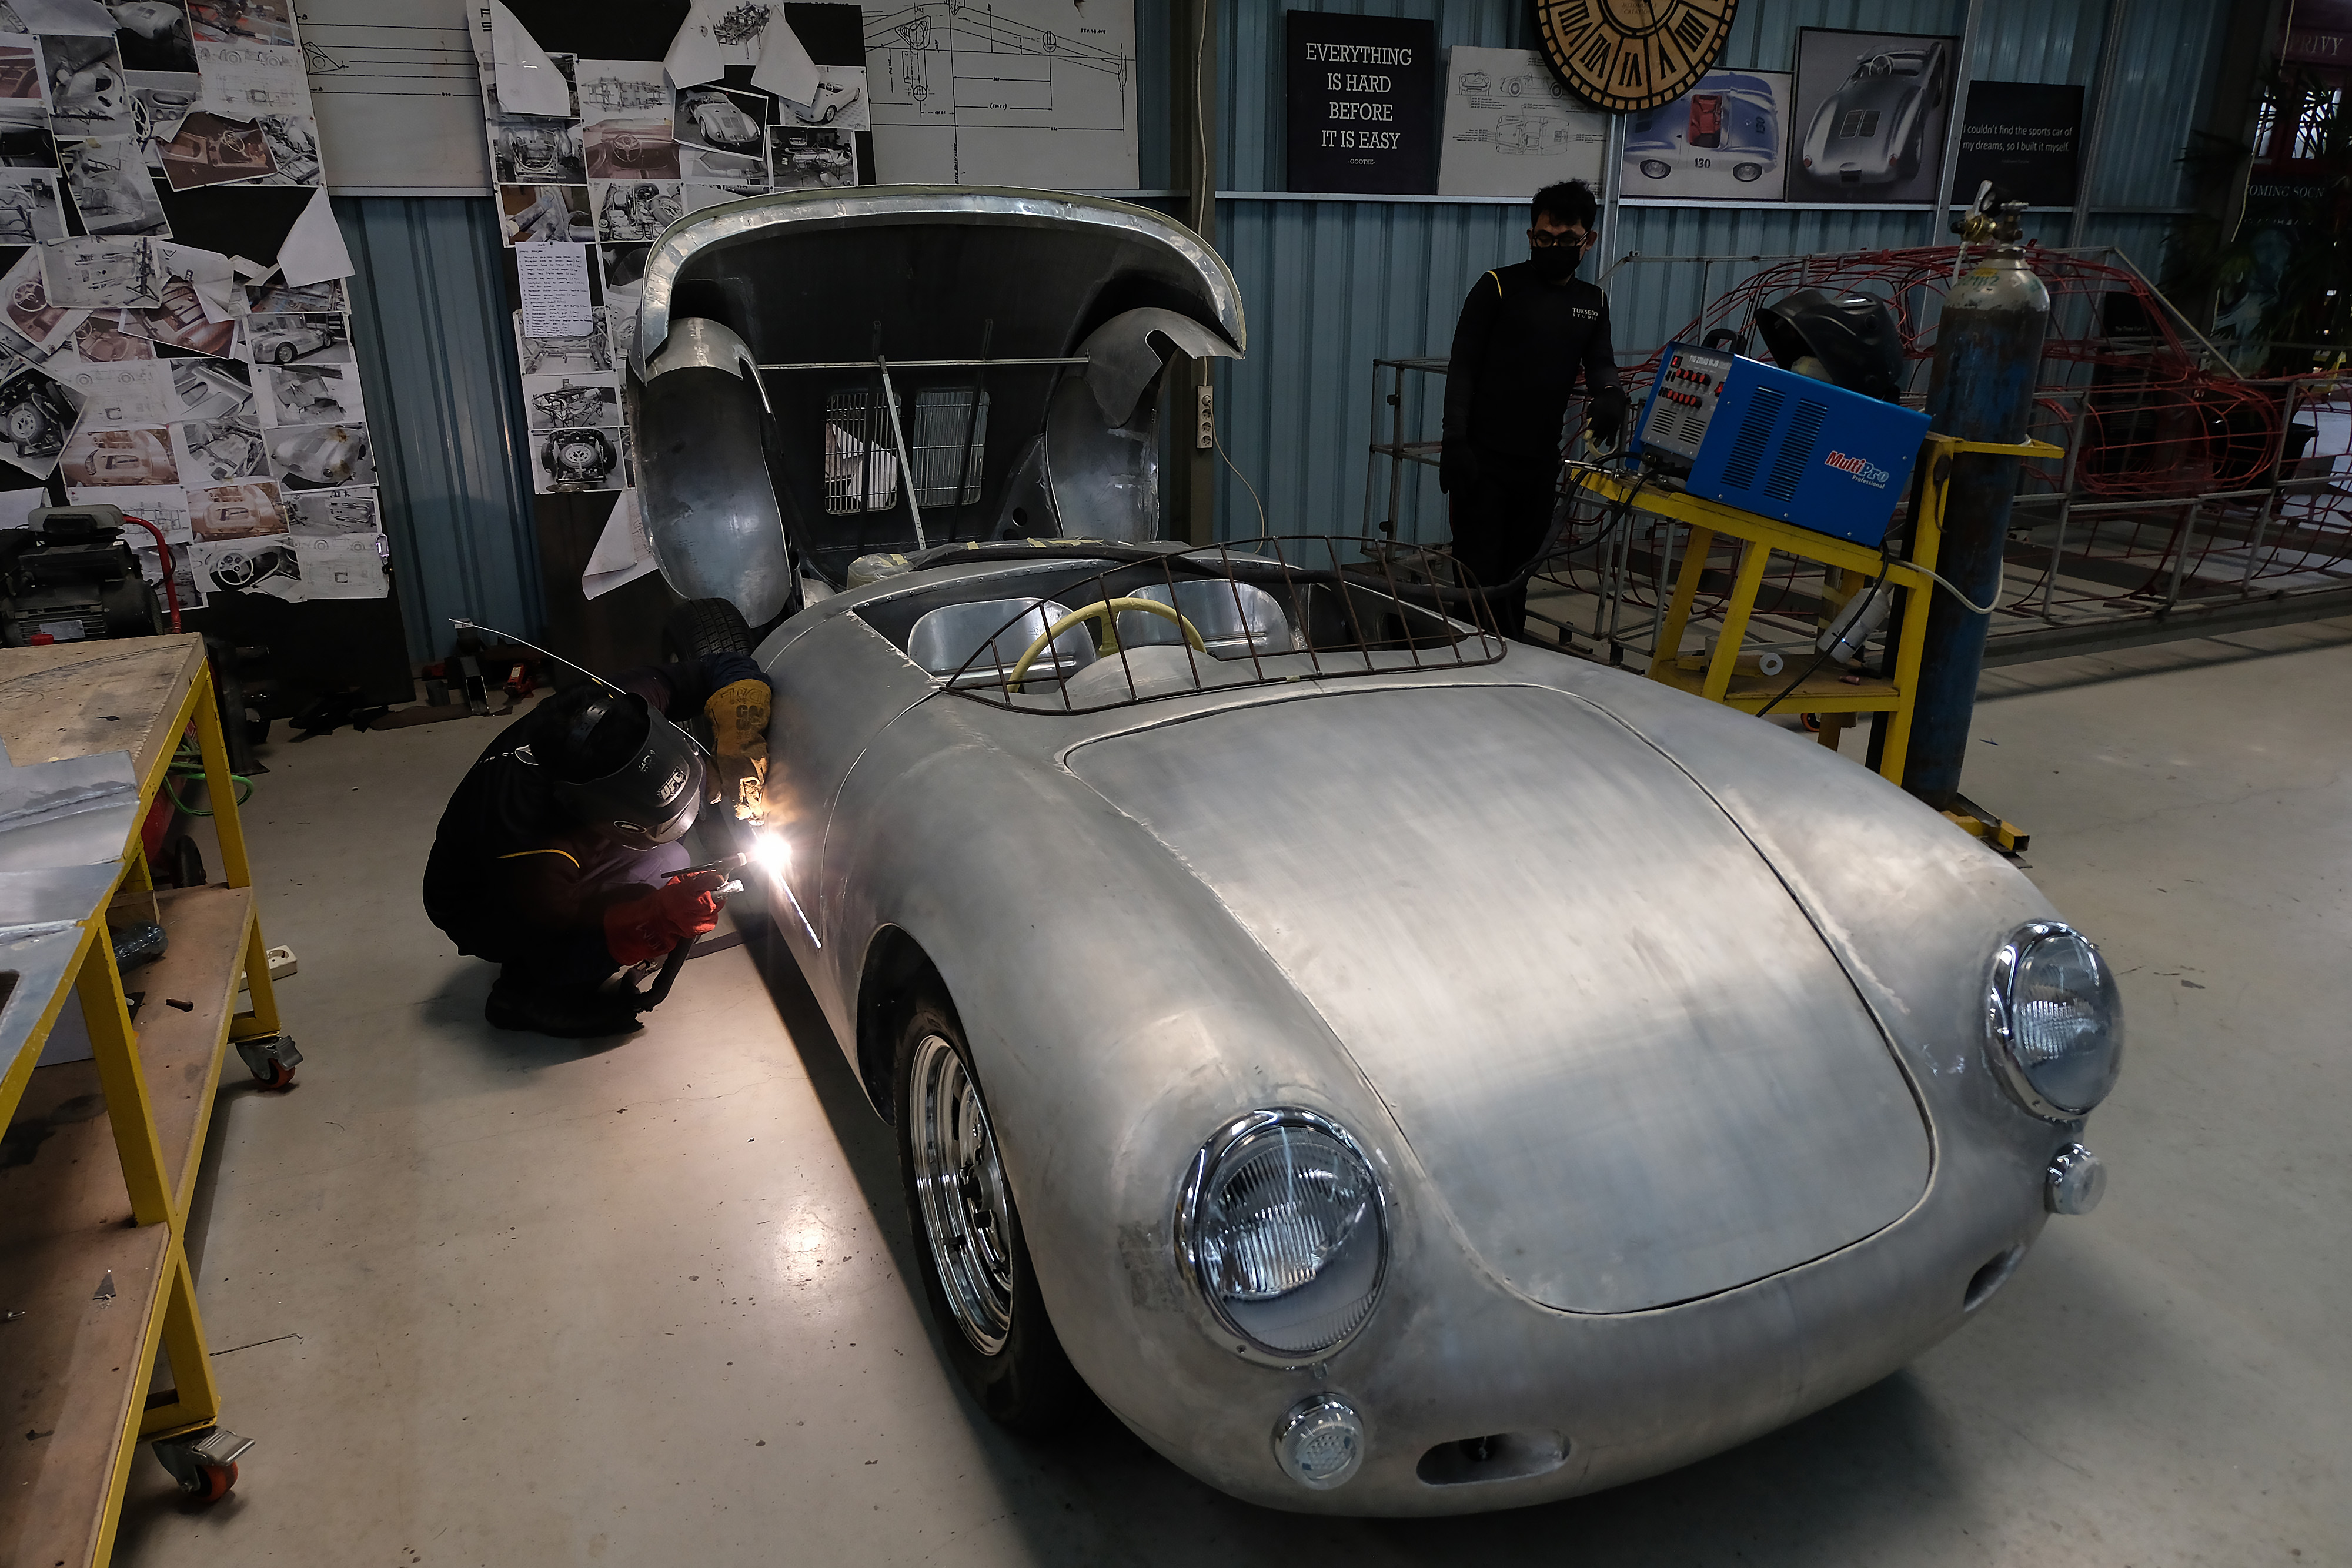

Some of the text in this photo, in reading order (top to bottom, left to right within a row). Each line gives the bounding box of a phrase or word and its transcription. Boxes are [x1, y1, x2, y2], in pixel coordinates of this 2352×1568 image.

[1306, 42, 1412, 66] EVERYTHING
[1327, 73, 1391, 93] IS HARD
[1329, 102, 1392, 121] BEFORE
[1967, 124, 1997, 135] couldn't
[1999, 124, 2013, 135] find
[2015, 125, 2027, 135] the
[2029, 126, 2050, 136] sports
[2052, 128, 2063, 136] car
[2064, 126, 2073, 136] of
[1321, 130, 1400, 149] IT IS EASY
[1963, 142, 1974, 151] my
[1976, 141, 2005, 152] dreams,
[2016, 142, 2019, 151] I
[2020, 142, 2037, 151] built
[2039, 143, 2044, 151] it
[2045, 143, 2070, 153] myself.
[1695, 158, 1710, 168] 130
[2247, 184, 2290, 198] OMING
[1572, 307, 1598, 317] TUKSEDO
[1825, 450, 1889, 483] MultiPro
[1852, 474, 1885, 489] Professional
[660, 771, 685, 800] UFC
